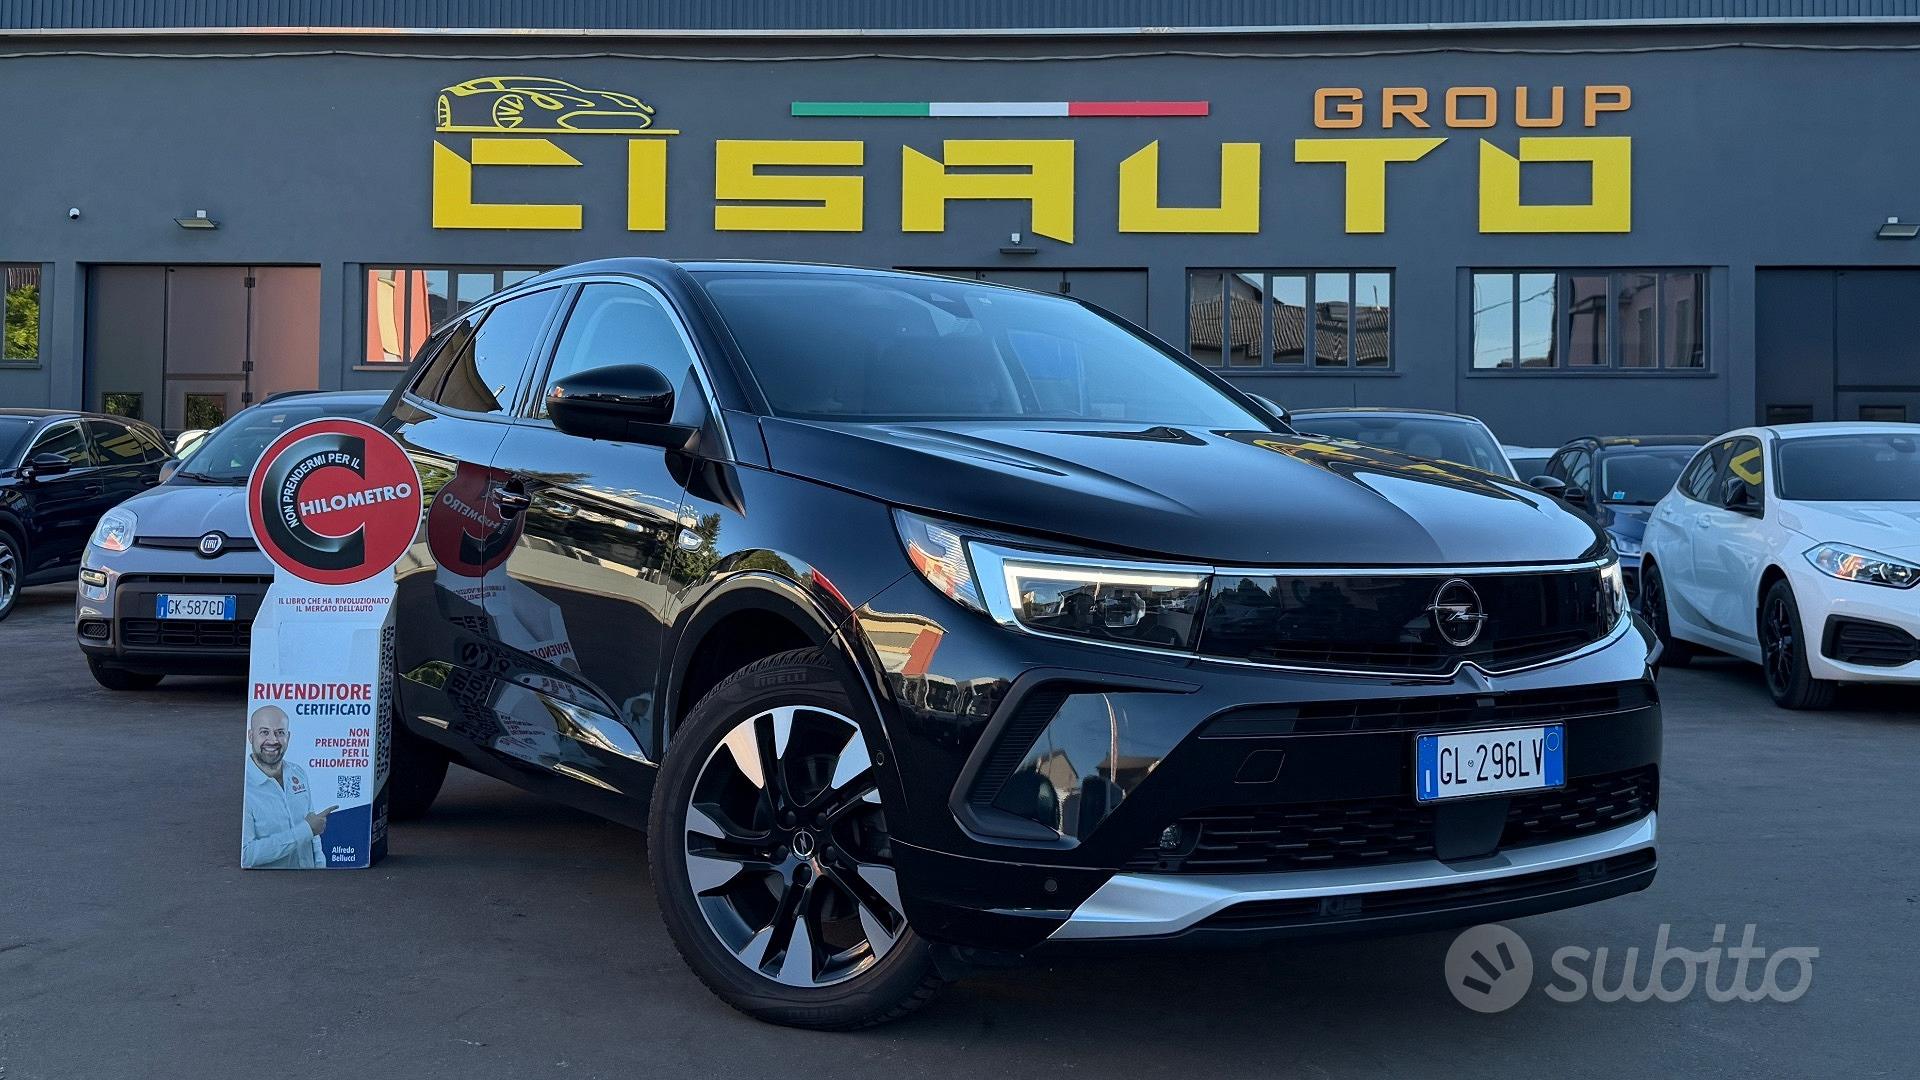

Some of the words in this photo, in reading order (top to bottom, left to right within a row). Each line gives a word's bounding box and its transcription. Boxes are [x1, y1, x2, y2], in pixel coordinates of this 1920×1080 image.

[1313, 85, 1632, 129] GROUP
[432, 136, 1633, 244] CISAUTO
[328, 453, 350, 465] PER
[350, 457, 360, 469] IL
[283, 454, 326, 503] PRENDERMI
[283, 505, 299, 529] NON
[278, 597, 284, 605] IL
[285, 597, 306, 605] LIBRO
[307, 597, 321, 605] CHE
[322, 597, 332, 605] HA
[335, 597, 390, 605] RIVOLUZIONATO
[296, 605, 303, 613] IL
[304, 605, 337, 613] MERCATO
[338, 605, 374, 613] DELL'AUTO
[253, 682, 372, 700] RIVENDITORE
[295, 703, 371, 716] CERTIFICATO
[349, 728, 370, 737] NON
[315, 738, 370, 747] PRENDERMI
[341, 748, 361, 758] PER
[362, 748, 370, 758] IL
[308, 758, 369, 768] CHILOMETRO
[331, 845, 355, 854] Alfredo
[331, 853, 356, 862] Bellucci
